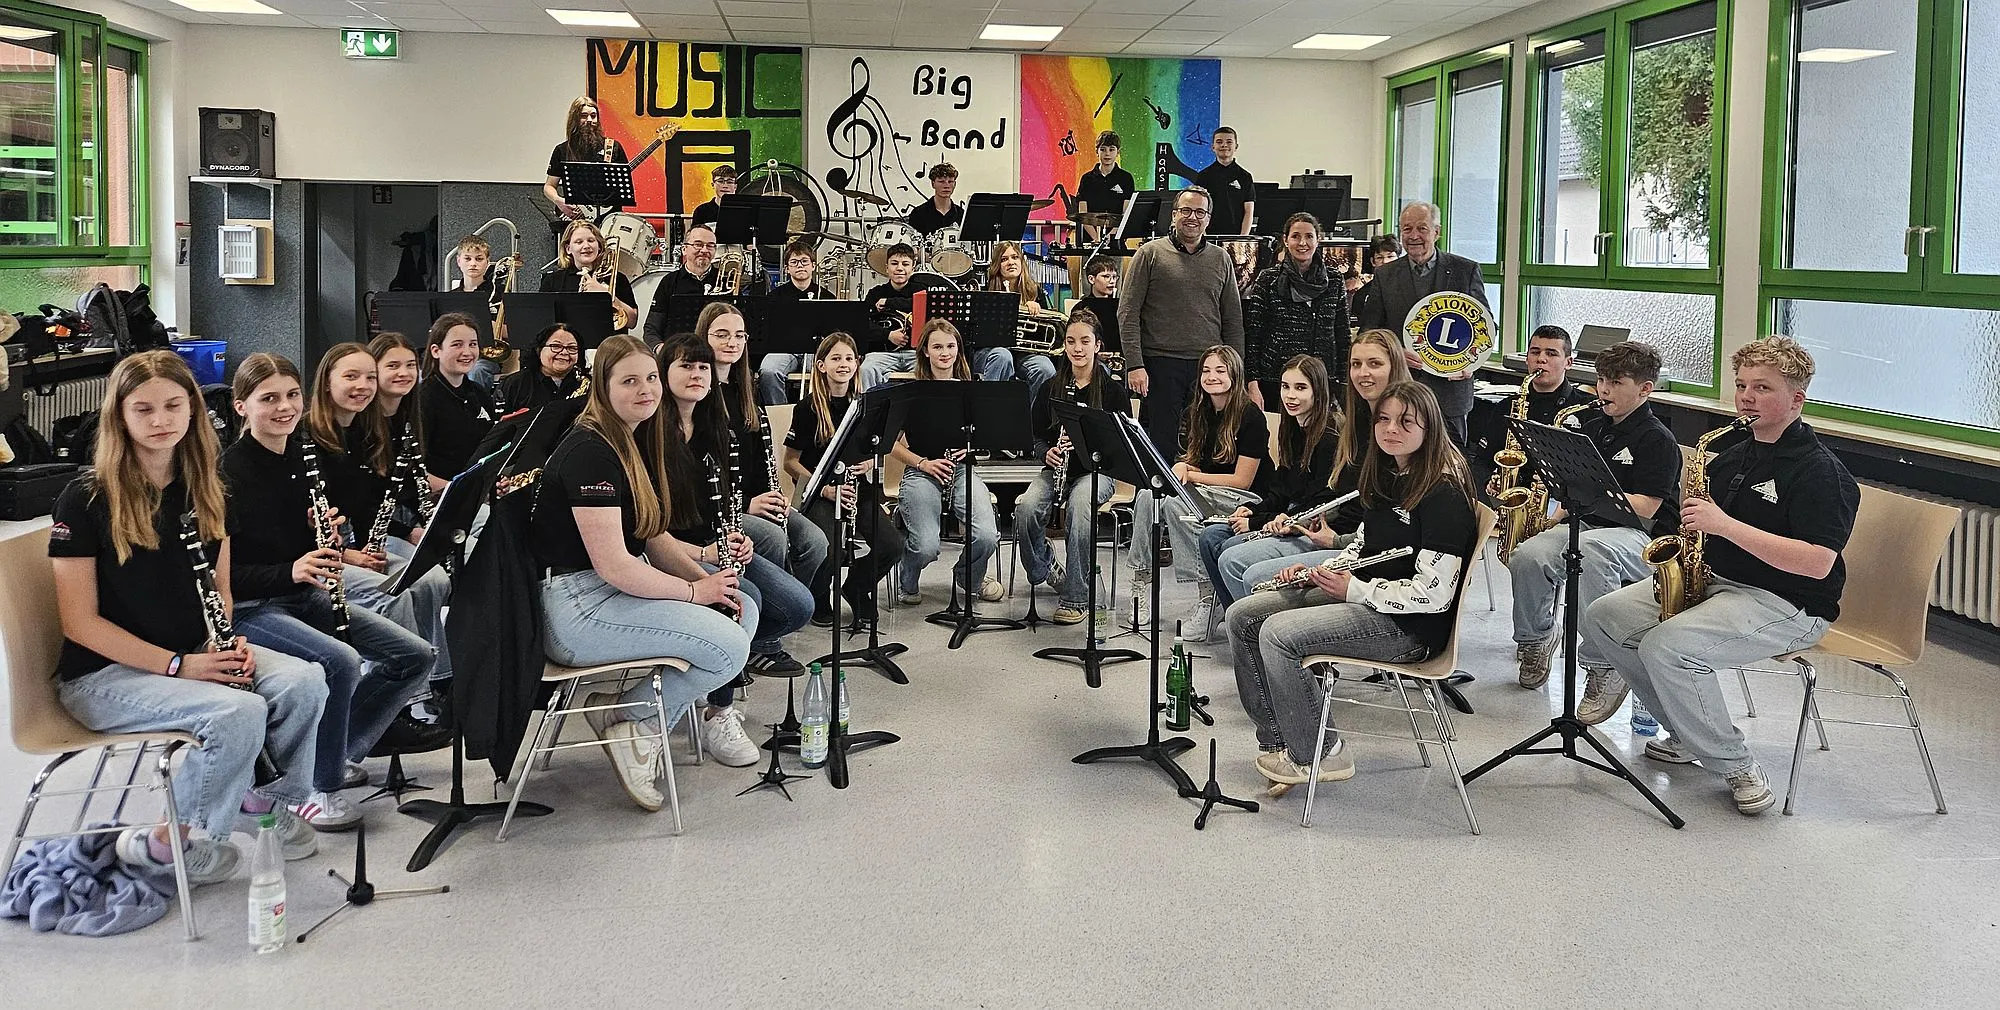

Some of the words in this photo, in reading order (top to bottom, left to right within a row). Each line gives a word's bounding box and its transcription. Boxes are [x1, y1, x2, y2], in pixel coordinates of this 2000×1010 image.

[586, 39, 803, 118] MUSIC
[912, 64, 972, 110] Big
[920, 117, 1006, 150] Band
[1433, 299, 1479, 320] LIONS
[1435, 317, 1459, 349] L
[1419, 345, 1471, 367] INTERNATIONAL
